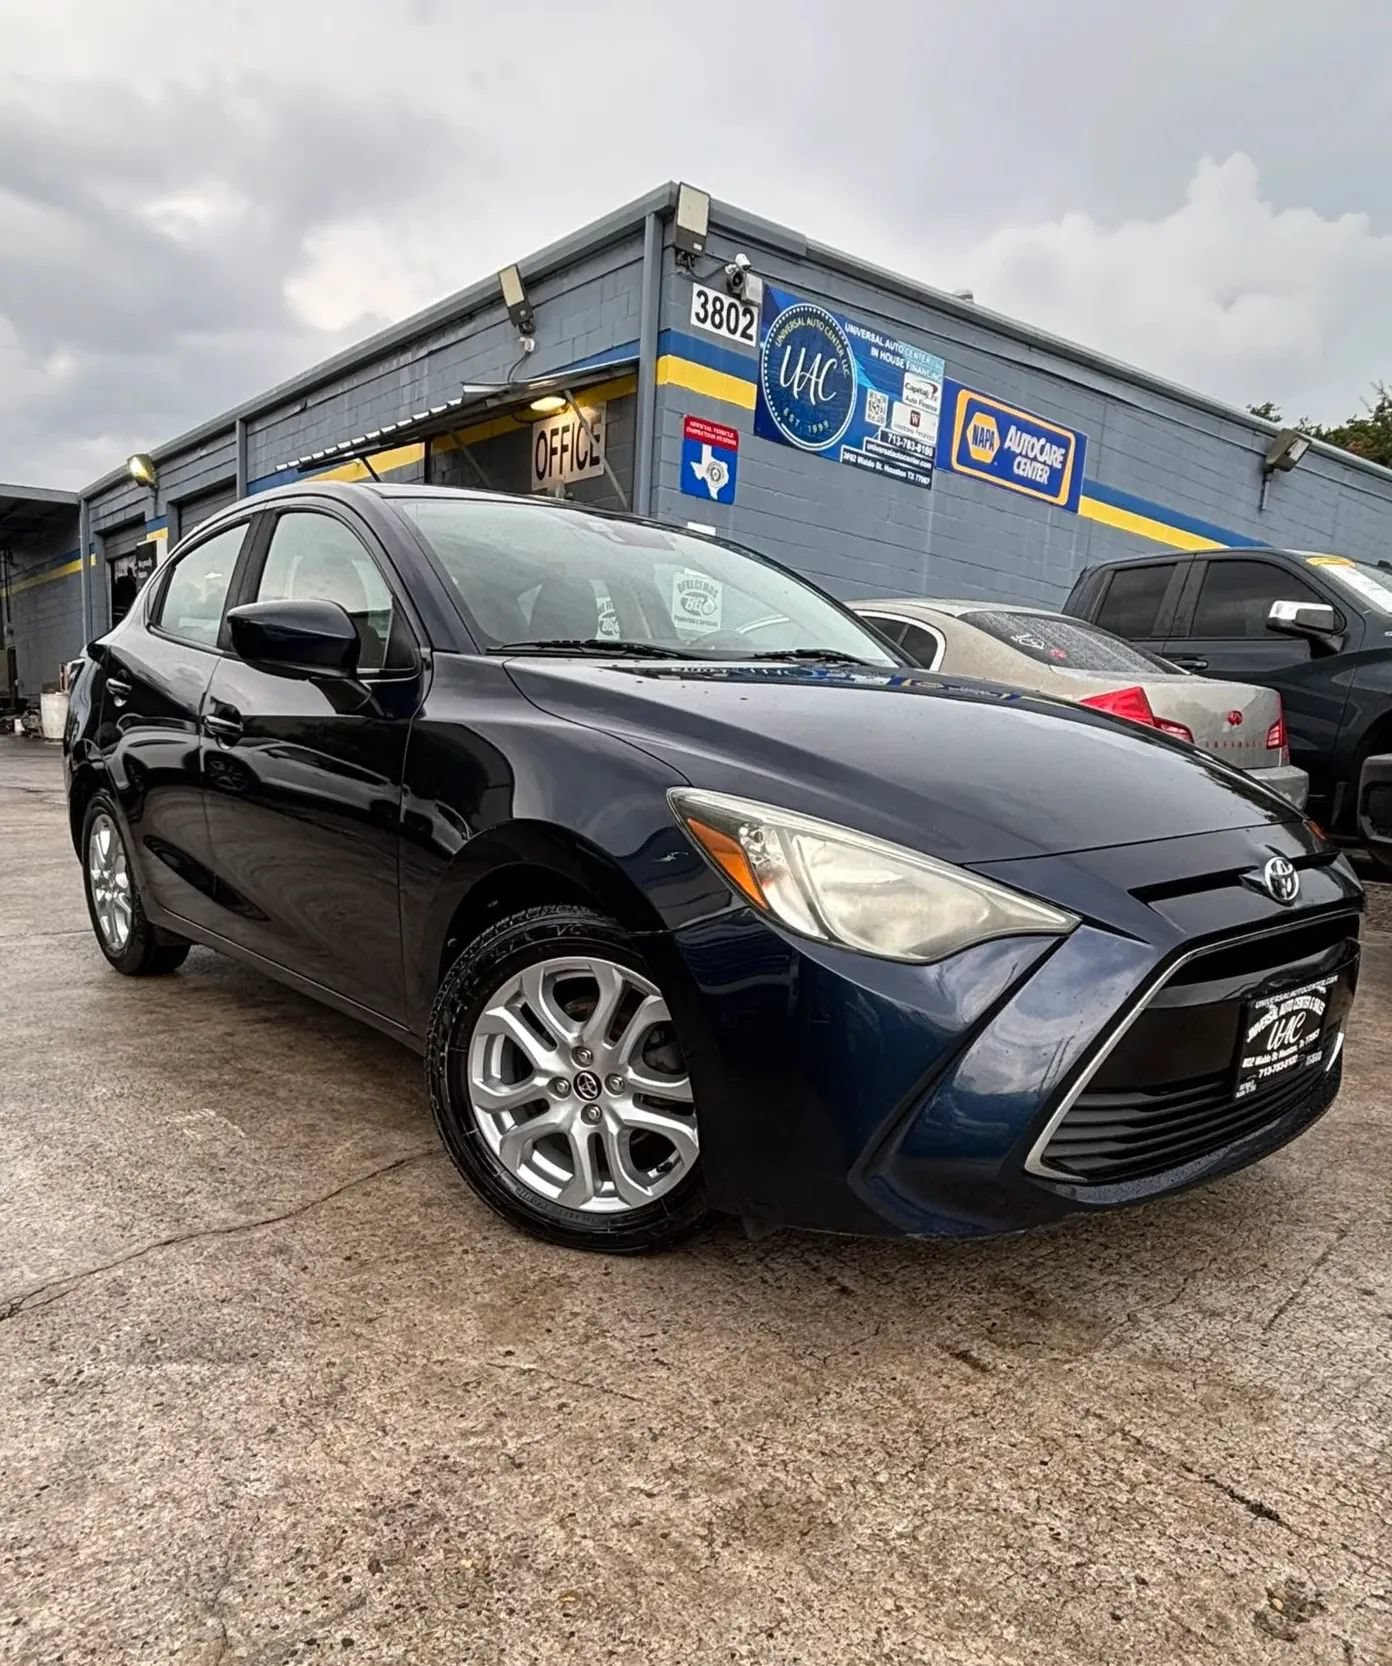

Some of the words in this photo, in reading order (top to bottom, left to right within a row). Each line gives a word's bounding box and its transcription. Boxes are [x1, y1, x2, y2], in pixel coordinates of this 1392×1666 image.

[695, 289, 755, 342] 3802
[774, 317, 806, 347] UNIVERSAL
[806, 317, 825, 331] AUTO
[824, 326, 844, 357] CENTER
[841, 359, 851, 378] LLC
[844, 322, 884, 346] UNIVERSAL
[884, 339, 904, 354] AUTO
[904, 345, 931, 363] CENTER
[870, 346, 879, 358] IN
[880, 350, 905, 368] HOUSE
[780, 345, 838, 406] UAC
[535, 421, 601, 481] OFFICE
[971, 424, 995, 452] NAPA
[1013, 456, 1050, 485] CENTER
[1267, 1011, 1307, 1051] UAC
